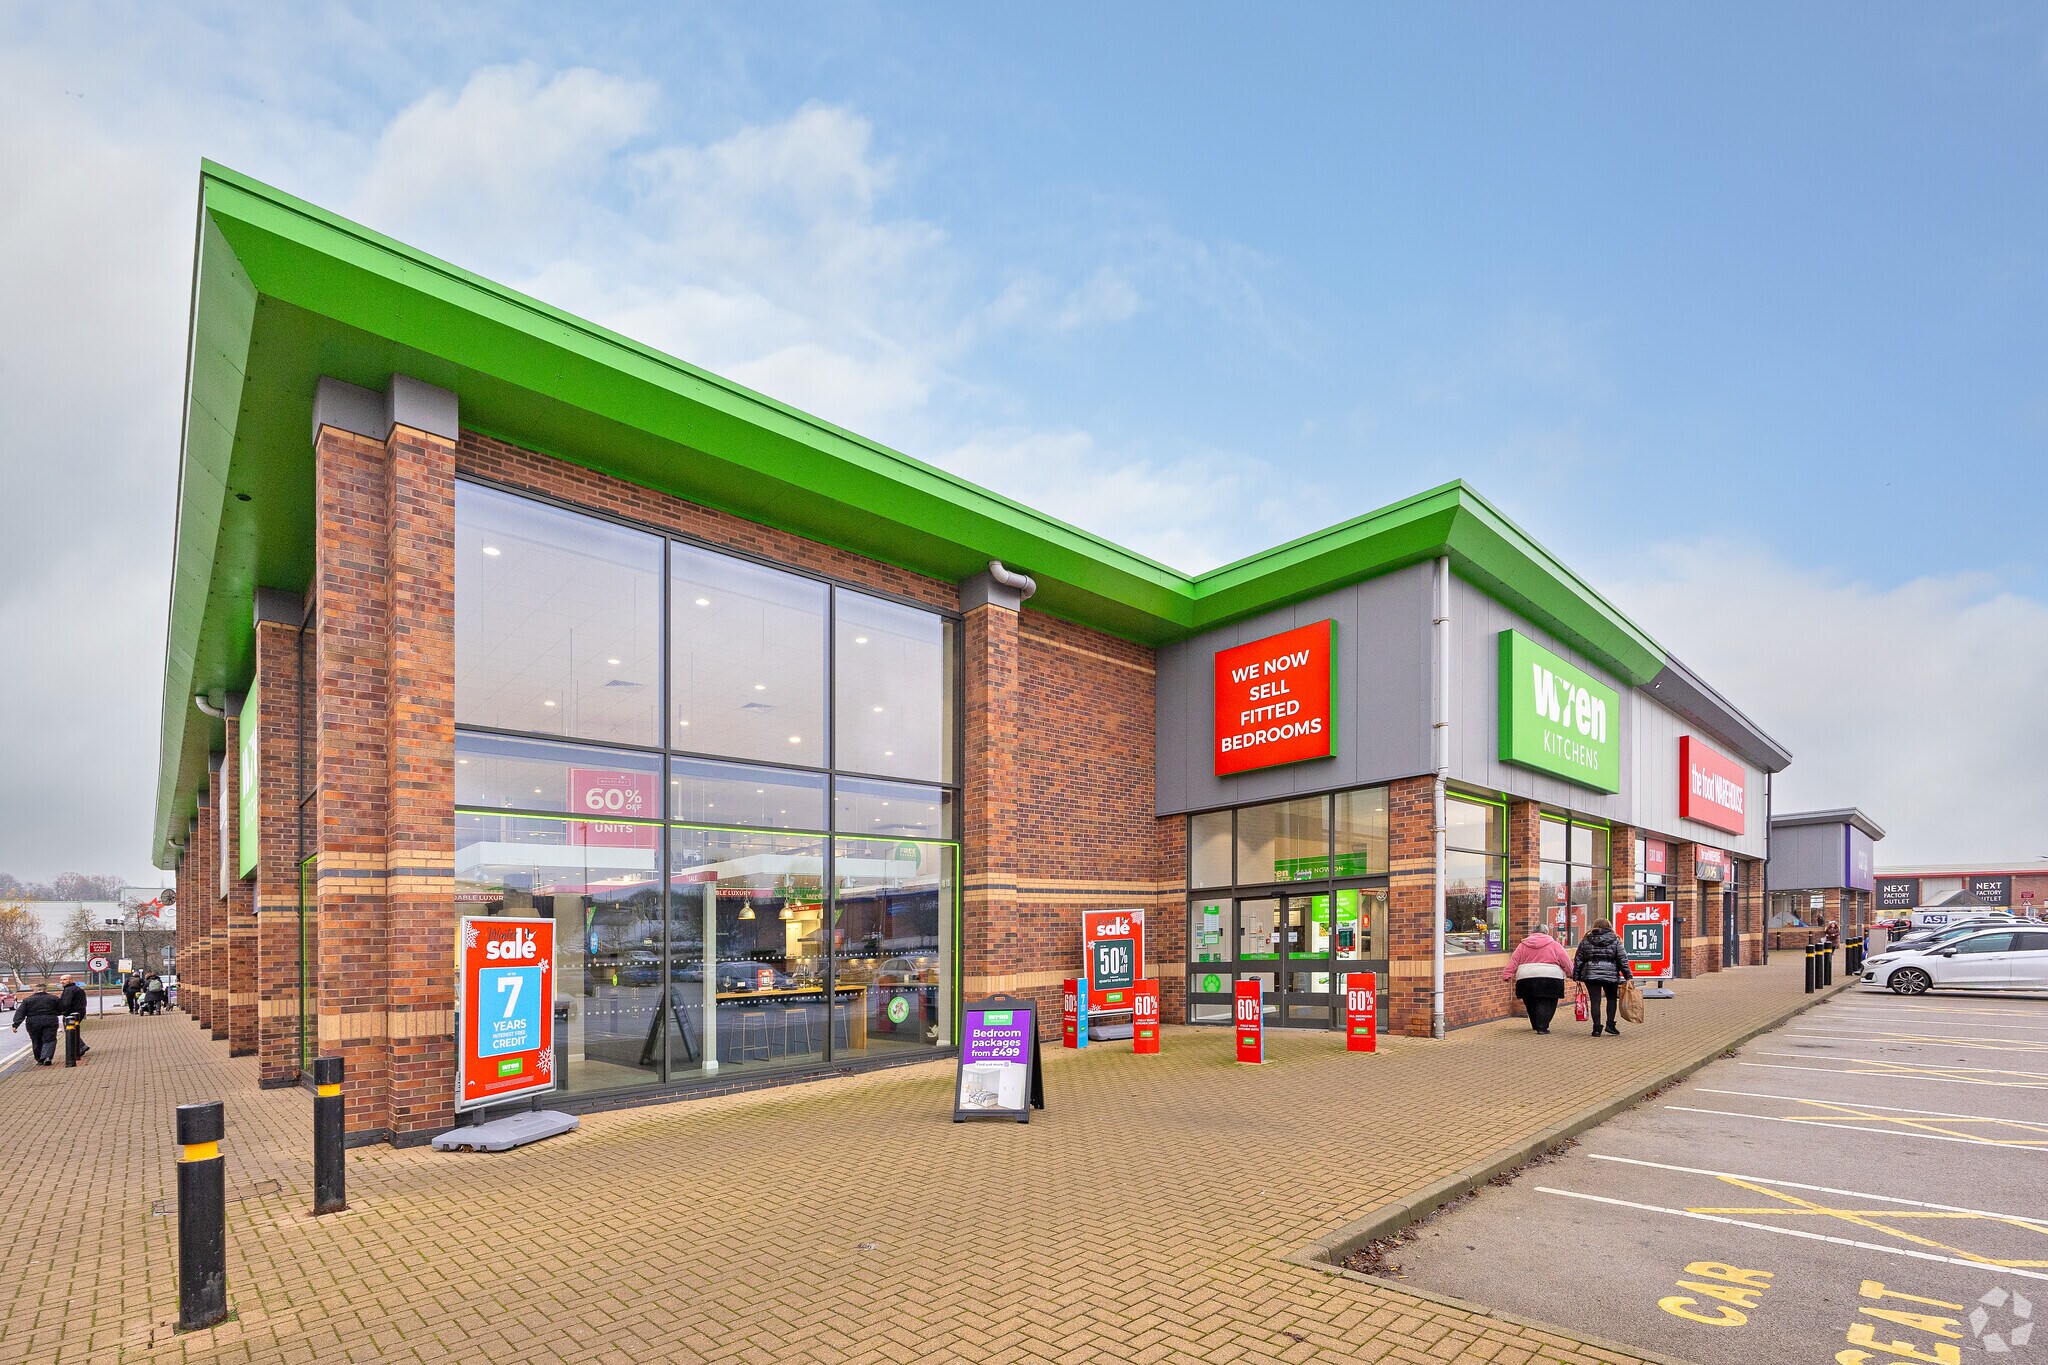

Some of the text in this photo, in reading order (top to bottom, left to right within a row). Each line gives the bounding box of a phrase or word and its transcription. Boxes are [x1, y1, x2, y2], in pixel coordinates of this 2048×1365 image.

[1231, 649, 1310, 684] WE NOW
[1249, 679, 1290, 701] SELL
[1240, 699, 1300, 727] FITTED
[1221, 717, 1322, 753] BEDROOMS
[1543, 729, 1598, 771] KITCHENS
[1691, 762, 1743, 815] the food WAREHOUSE
[585, 787, 642, 811] 60%
[625, 803, 642, 811] OFF
[594, 824, 633, 833] UNITS
[900, 847, 917, 855] FREE
[1314, 866, 1330, 874] NOW
[1976, 882, 2002, 890] NEXT
[1627, 906, 1660, 921] sale
[1923, 915, 1948, 924] ASI
[1096, 916, 1131, 937] sale
[486, 927, 537, 960] sale
[1649, 942, 1658, 950] off
[95, 960, 102, 968] 5
[1100, 947, 1128, 975] 50%
[1120, 963, 1128, 974] off
[497, 976, 524, 1018] 7
[1135, 995, 1158, 1016] 60%
[1348, 990, 1374, 1011] 60%
[1238, 999, 1260, 1020] 60%
[493, 1018, 527, 1032] YEARS
[972, 1028, 1022, 1038] Bedroom
[971, 1047, 1020, 1057] from £499
[972, 1038, 1021, 1048] packages
[501, 1062, 520, 1071] wren
[1657, 1261, 1775, 1327] CAR
